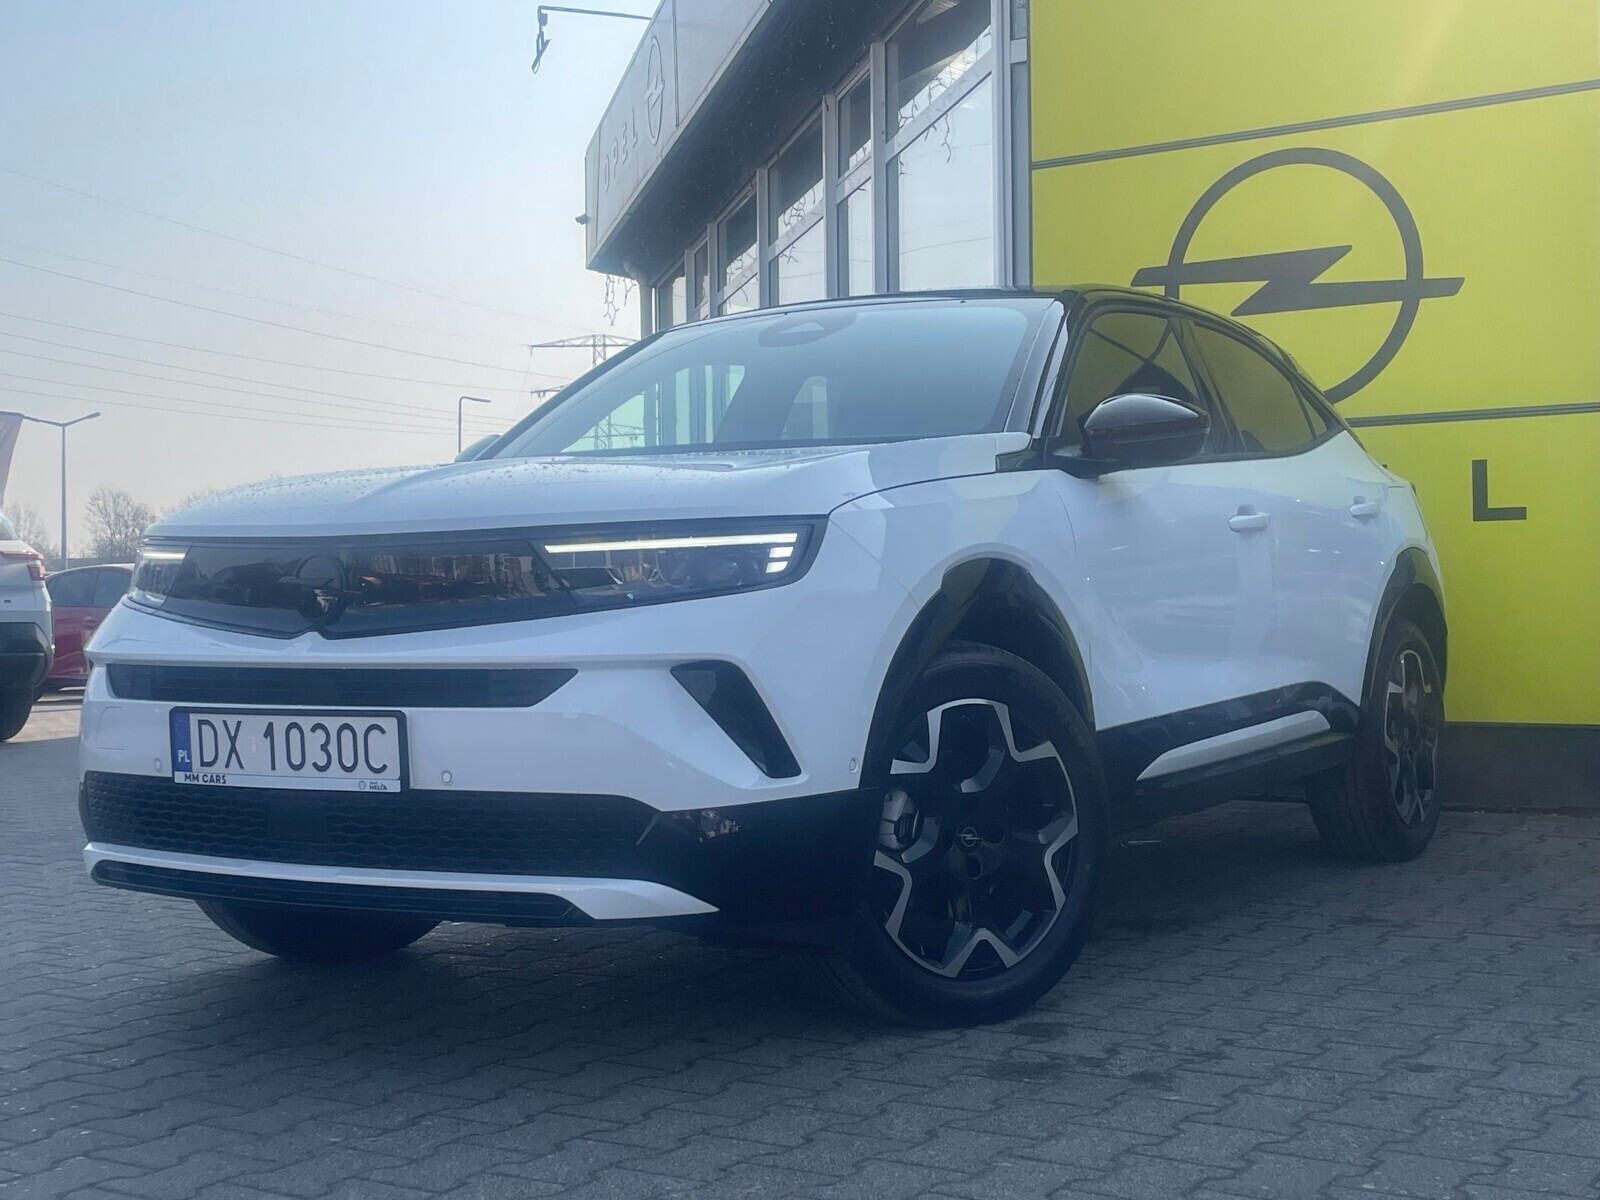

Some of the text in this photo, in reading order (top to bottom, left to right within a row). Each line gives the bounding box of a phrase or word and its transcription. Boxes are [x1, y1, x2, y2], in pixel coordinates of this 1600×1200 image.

[604, 107, 638, 193] OPEL
[178, 750, 191, 763] PL
[197, 719, 388, 774] DX 1030C
[184, 773, 227, 785] MM CARS
